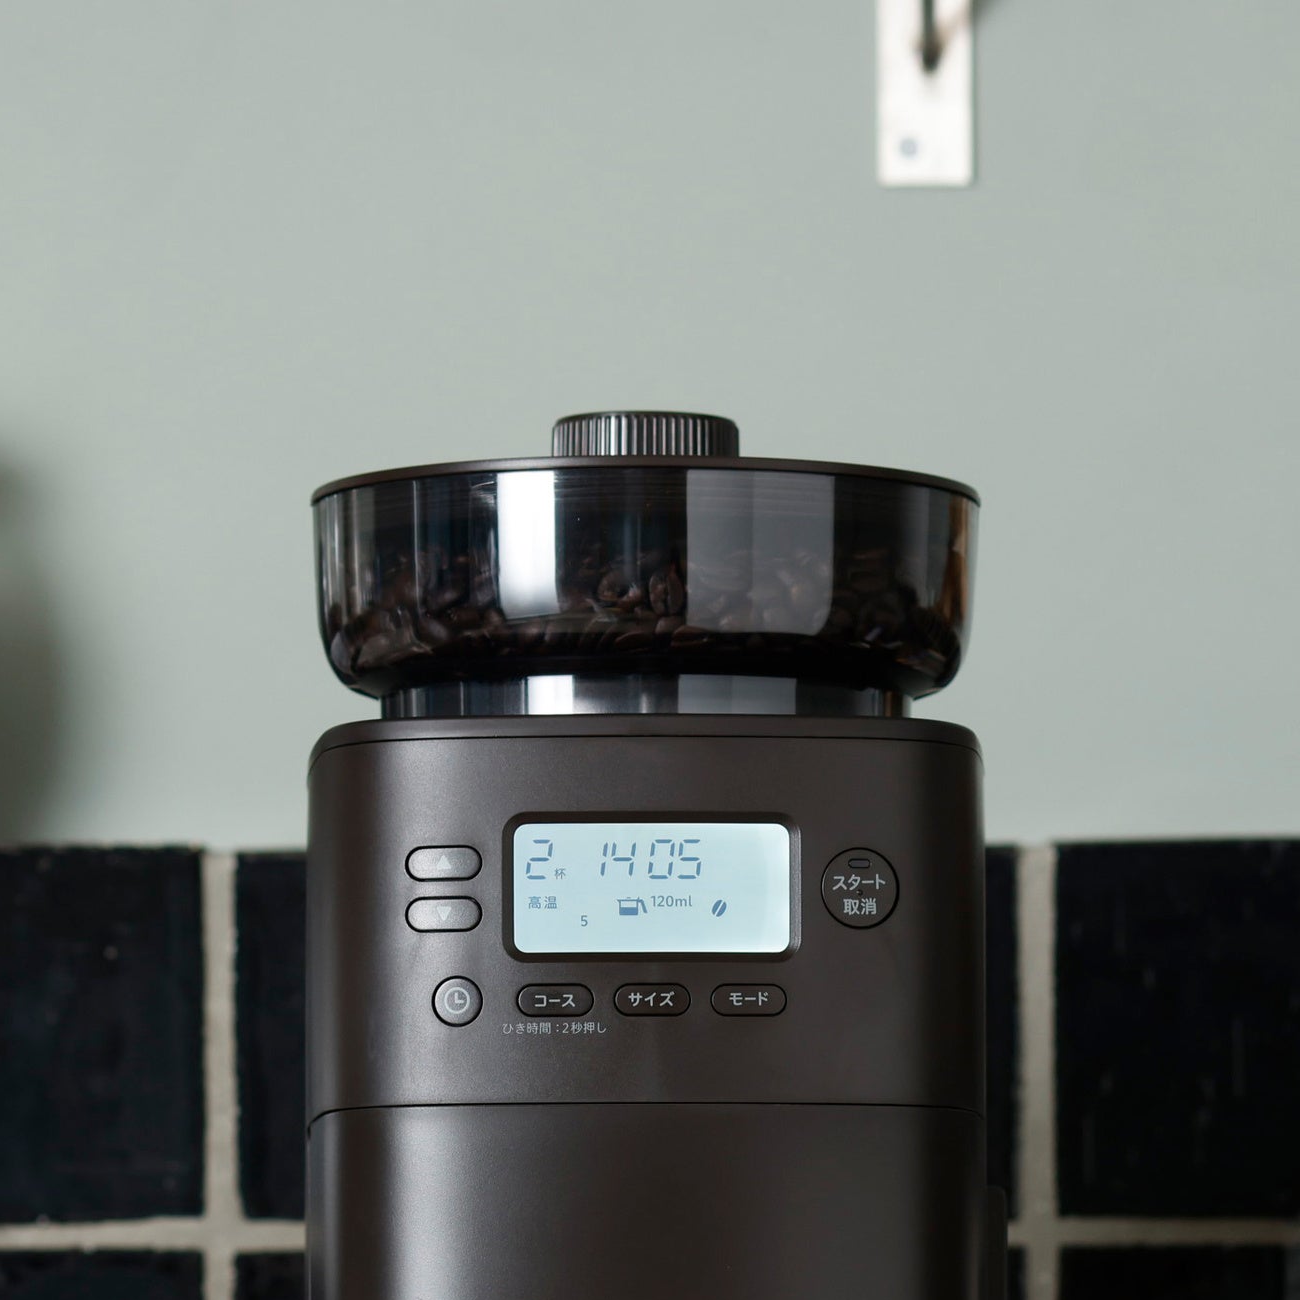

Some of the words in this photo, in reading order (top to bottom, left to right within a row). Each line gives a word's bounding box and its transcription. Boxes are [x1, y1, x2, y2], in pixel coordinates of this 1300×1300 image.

[526, 839, 553, 880] 2
[832, 873, 886, 890] スタート
[528, 896, 557, 909] 高温
[650, 895, 692, 907] 120ml
[843, 898, 877, 915] 取消
[580, 915, 589, 927] 5
[534, 994, 576, 1008] コース
[628, 991, 674, 1007] サイズ
[729, 992, 769, 1006] モード
